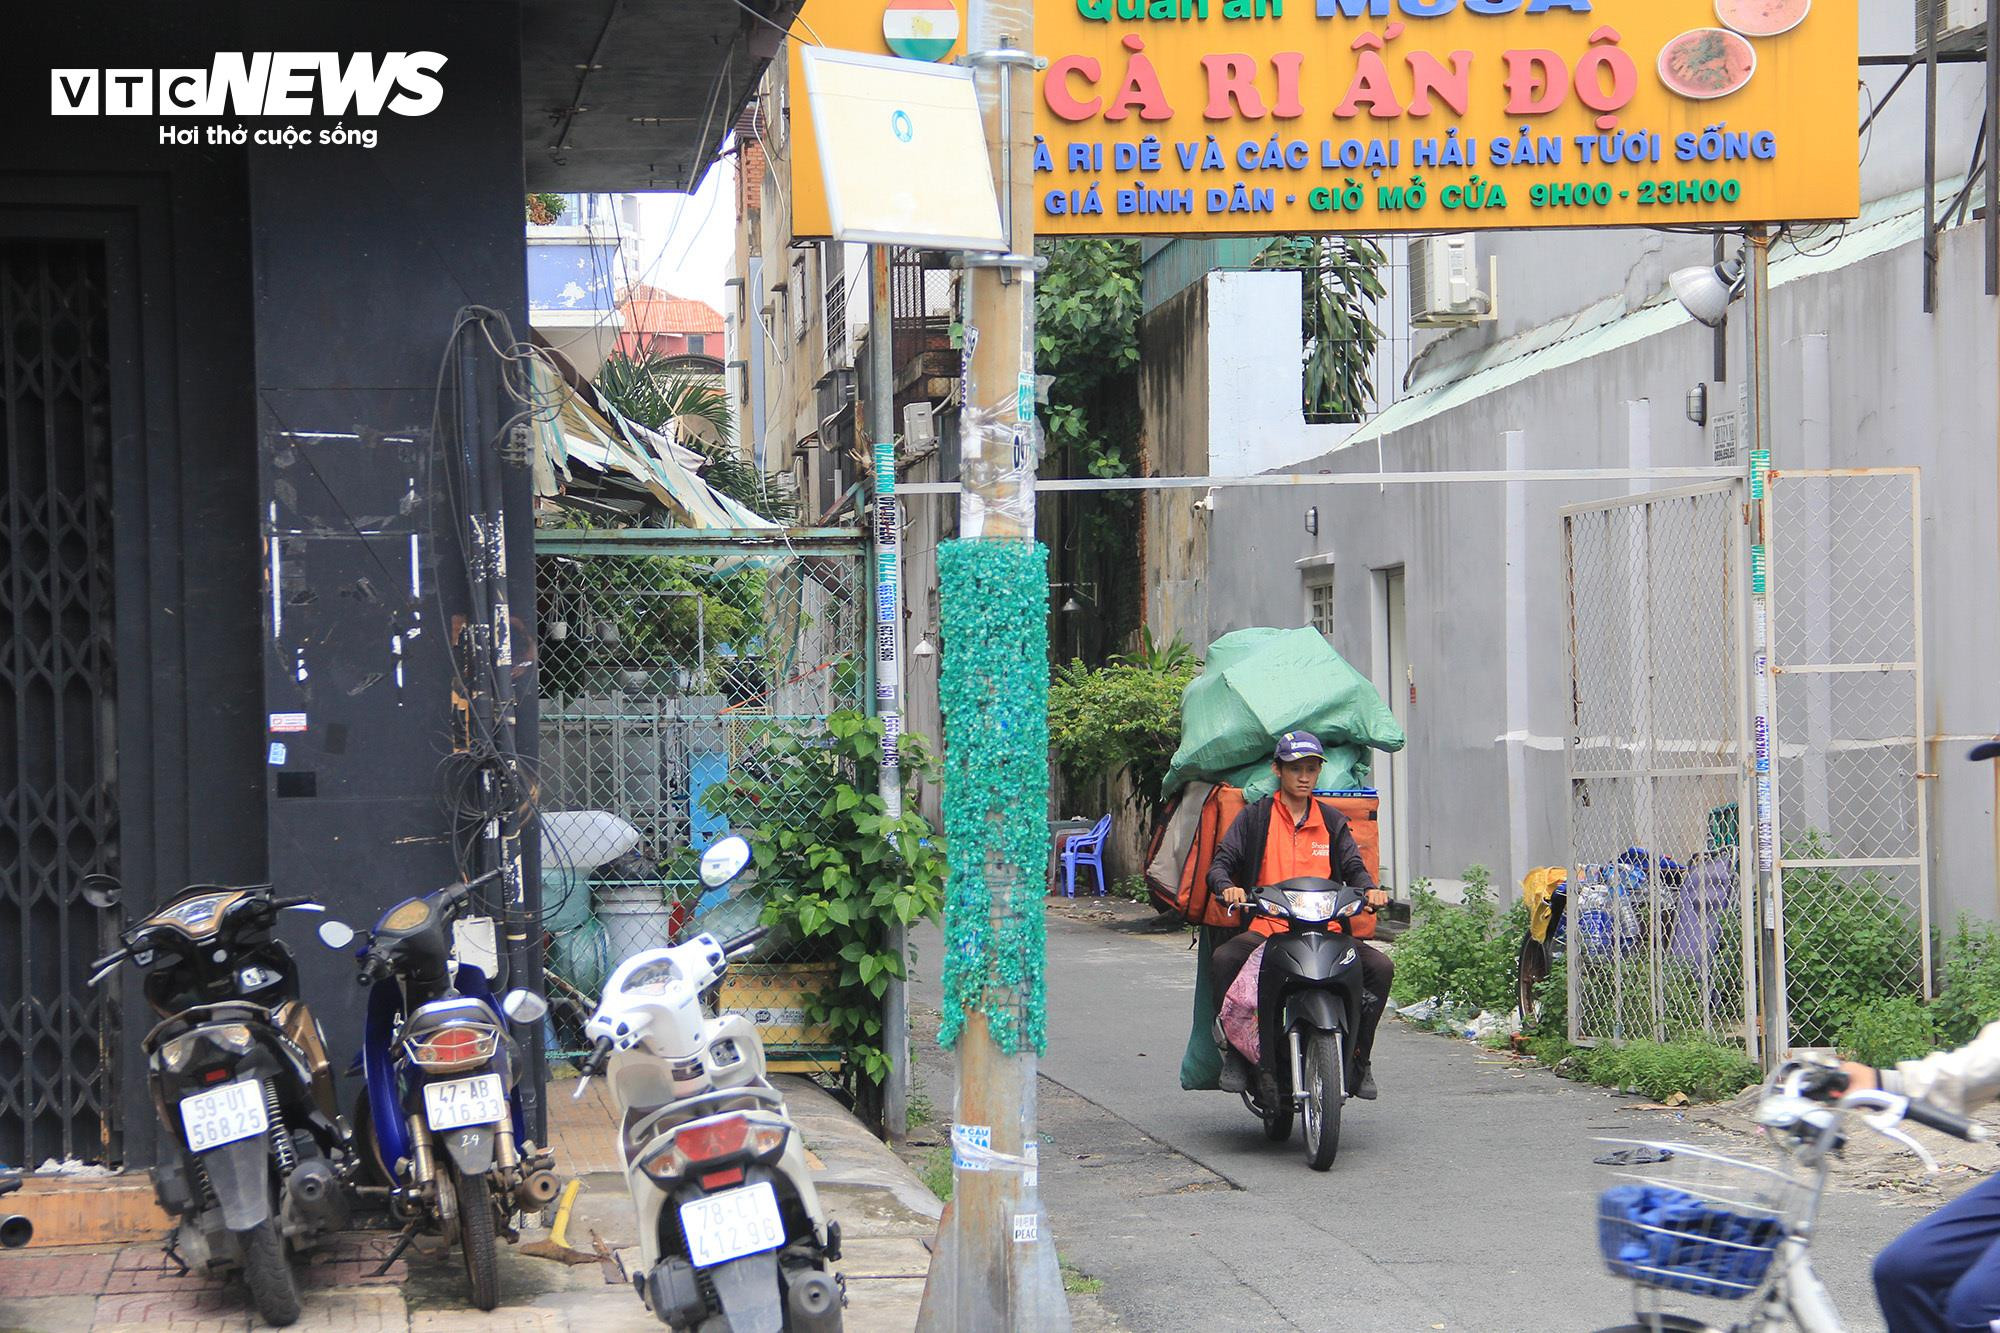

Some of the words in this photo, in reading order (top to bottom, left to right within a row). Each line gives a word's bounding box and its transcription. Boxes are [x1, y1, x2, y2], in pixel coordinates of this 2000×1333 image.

[1044, 33, 1175, 121] CÀ
[1200, 51, 1305, 119] RI
[1333, 22, 1474, 117] ẤN
[1502, 25, 1638, 130] ĐỘ
[1034, 135, 1053, 172] À
[1068, 143, 1102, 172] RI
[1115, 135, 1162, 171] DÊ
[1176, 135, 1225, 171] VÀ
[1237, 133, 1309, 170] CÁC
[1321, 139, 1399, 178] LOẠI
[1414, 128, 1476, 167] HẢI
[1490, 124, 1562, 166] SẢN
[1575, 129, 1661, 164] TƯƠI
[1675, 121, 1777, 161] SỐNG
[1045, 181, 1103, 215] GIÁ
[1117, 181, 1193, 214] BÌNH
[1207, 182, 1275, 213] DÂN
[1309, 177, 1365, 212] GIỜ
[1378, 175, 1427, 210] MỞ
[1441, 175, 1508, 210] CỬA
[1530, 181, 1613, 208] 9H00
[1637, 178, 1742, 205] 23H00
[193, 1087, 248, 1121] 59-U1
[440, 1080, 489, 1104] 47-AB
[192, 1107, 261, 1146] 568.25
[434, 1098, 501, 1127] 216.33
